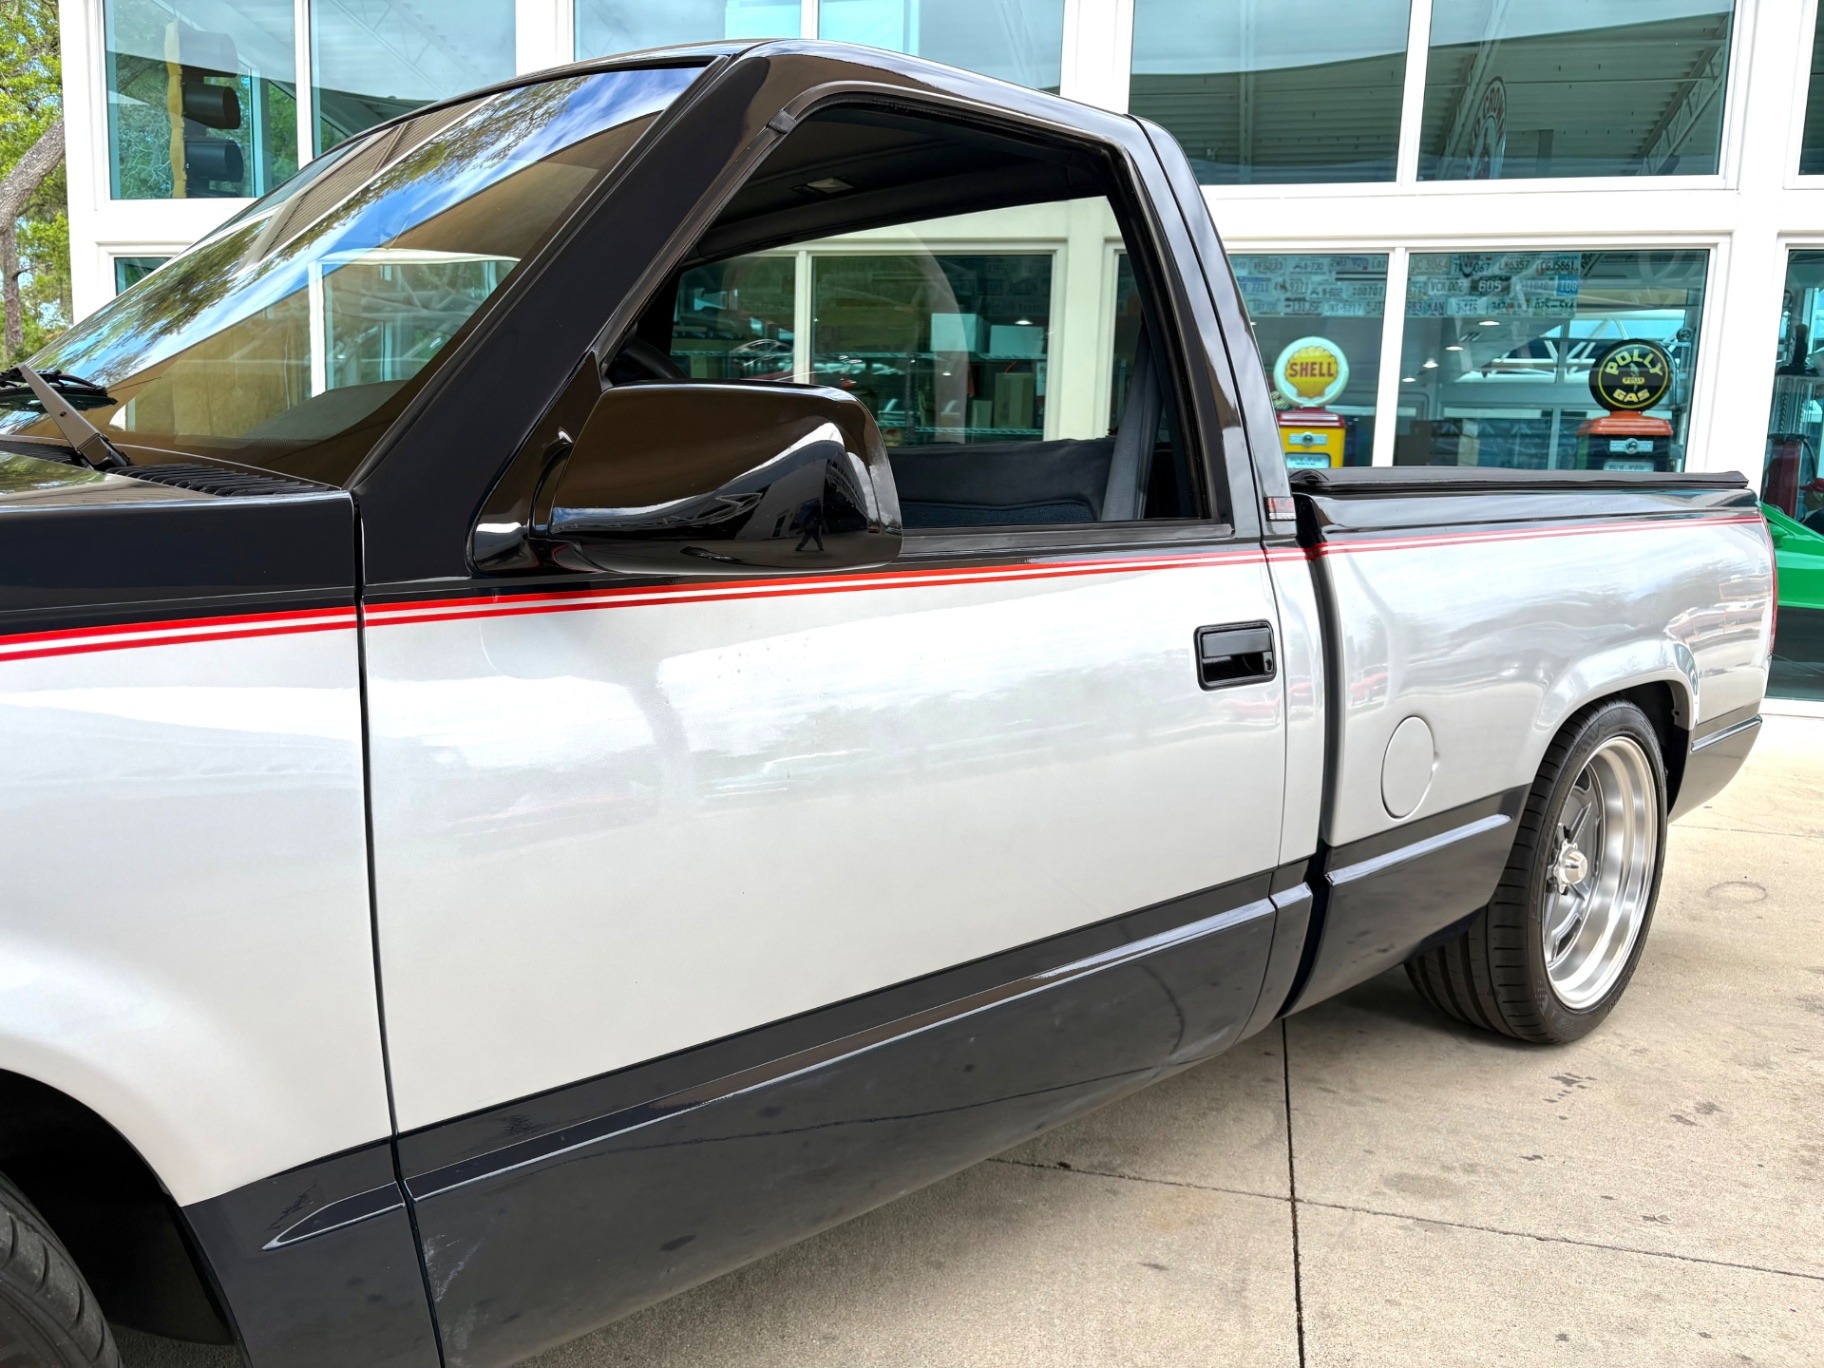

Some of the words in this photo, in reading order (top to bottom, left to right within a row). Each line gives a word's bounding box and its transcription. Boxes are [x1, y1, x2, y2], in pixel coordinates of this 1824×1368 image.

[1478, 280, 1502, 292] 605
[1289, 362, 1334, 378] SHELL
[1605, 349, 1663, 376] POLLY
[1612, 388, 1650, 402] GAS
